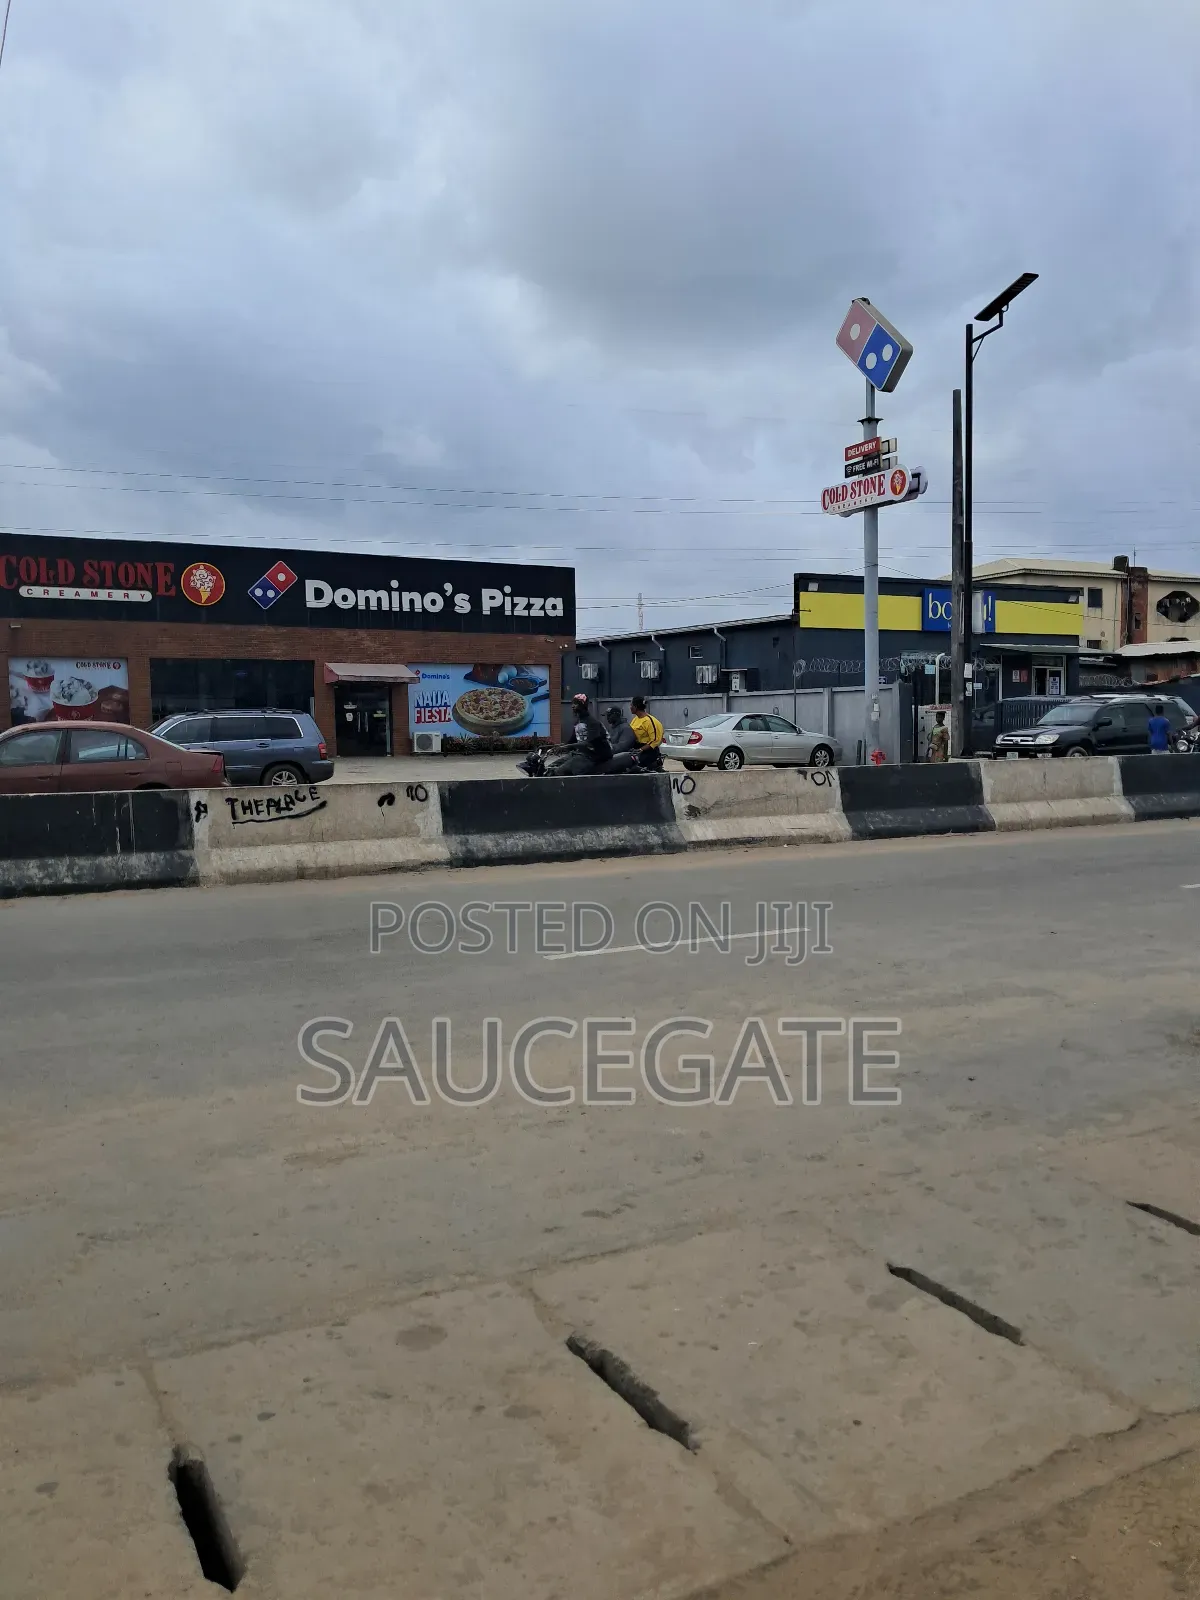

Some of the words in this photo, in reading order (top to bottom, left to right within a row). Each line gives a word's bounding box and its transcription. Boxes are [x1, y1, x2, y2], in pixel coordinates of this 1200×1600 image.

[847, 441, 876, 457] DELIVERY
[852, 462, 866, 473] FREE
[822, 485, 848, 510] COLD
[850, 474, 885, 499] STONE
[0, 554, 76, 590] COLD
[82, 559, 176, 597] STONE
[26, 587, 146, 600] CREAMERY
[304, 579, 472, 614] Domino's
[481, 585, 564, 617] Pizza
[421, 672, 450, 680] Domino's
[414, 706, 453, 724] FIESTA
